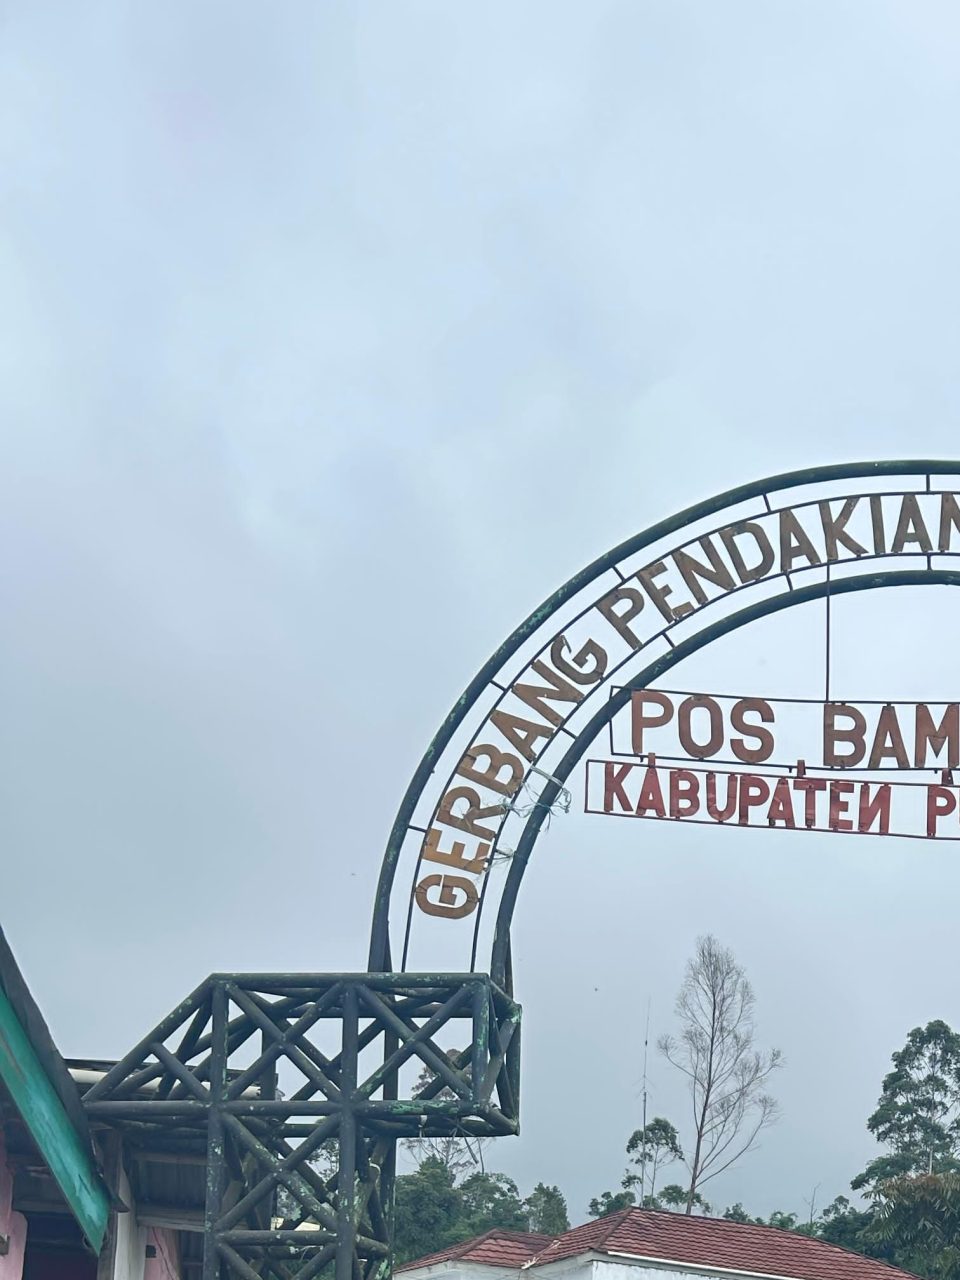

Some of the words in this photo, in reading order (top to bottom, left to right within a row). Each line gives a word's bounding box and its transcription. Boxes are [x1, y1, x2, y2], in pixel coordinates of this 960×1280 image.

[631, 690, 776, 763] POS
[414, 634, 609, 919] GERBANG
[603, 762, 890, 834] KABUPATEN
